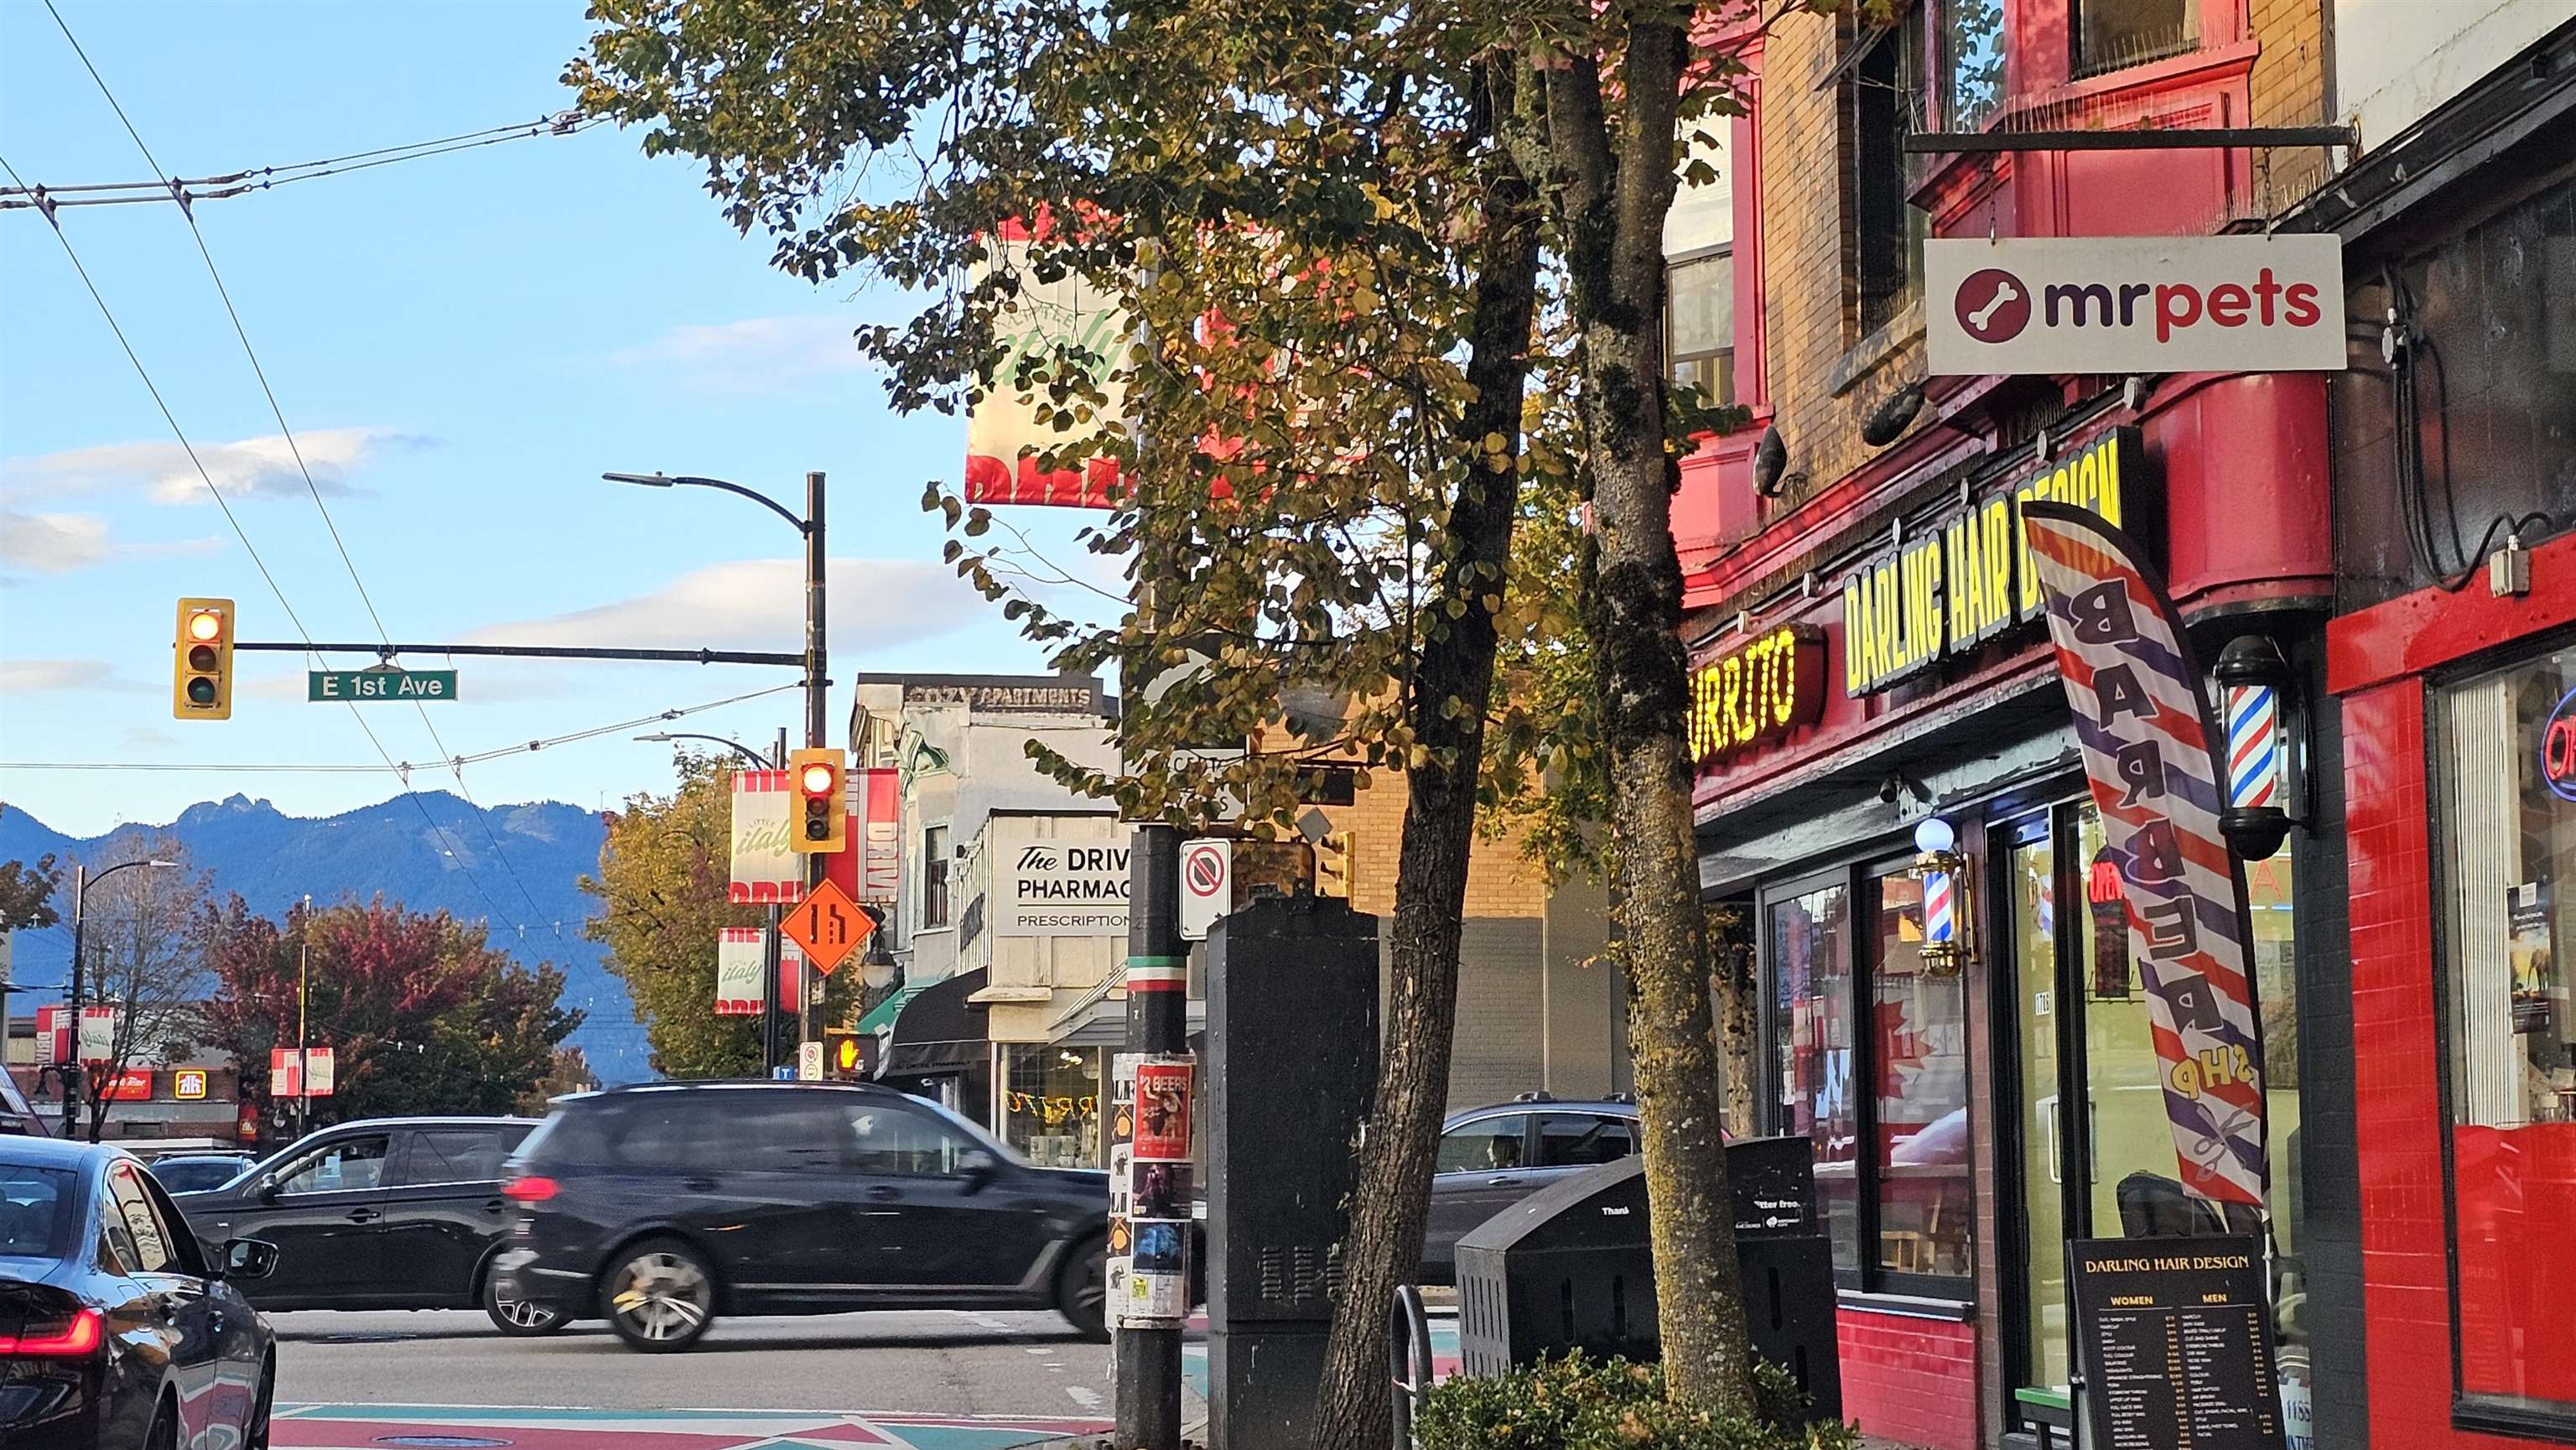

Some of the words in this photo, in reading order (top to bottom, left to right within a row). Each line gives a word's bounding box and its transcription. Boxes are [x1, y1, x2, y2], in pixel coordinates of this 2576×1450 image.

[2044, 268, 2321, 344] mrpets
[1845, 537, 1942, 693] DARLING
[1948, 501, 2010, 644] HAIR
[323, 676, 339, 696] E
[351, 676, 386, 696] 1st
[397, 675, 443, 696] Ave
[909, 686, 978, 704] COZY
[980, 687, 1091, 705] APARTMENTS
[1017, 845, 1058, 871] The
[722, 959, 762, 985] italy
[1153, 1076, 1188, 1092] BEERS
[2085, 1259, 2150, 1272] DARLING
[2155, 1257, 2190, 1271] HAIR
[2194, 1256, 2250, 1270] DESIGN
[2111, 1297, 2153, 1306] WOMEN
[2202, 1293, 2227, 1303] MEN
